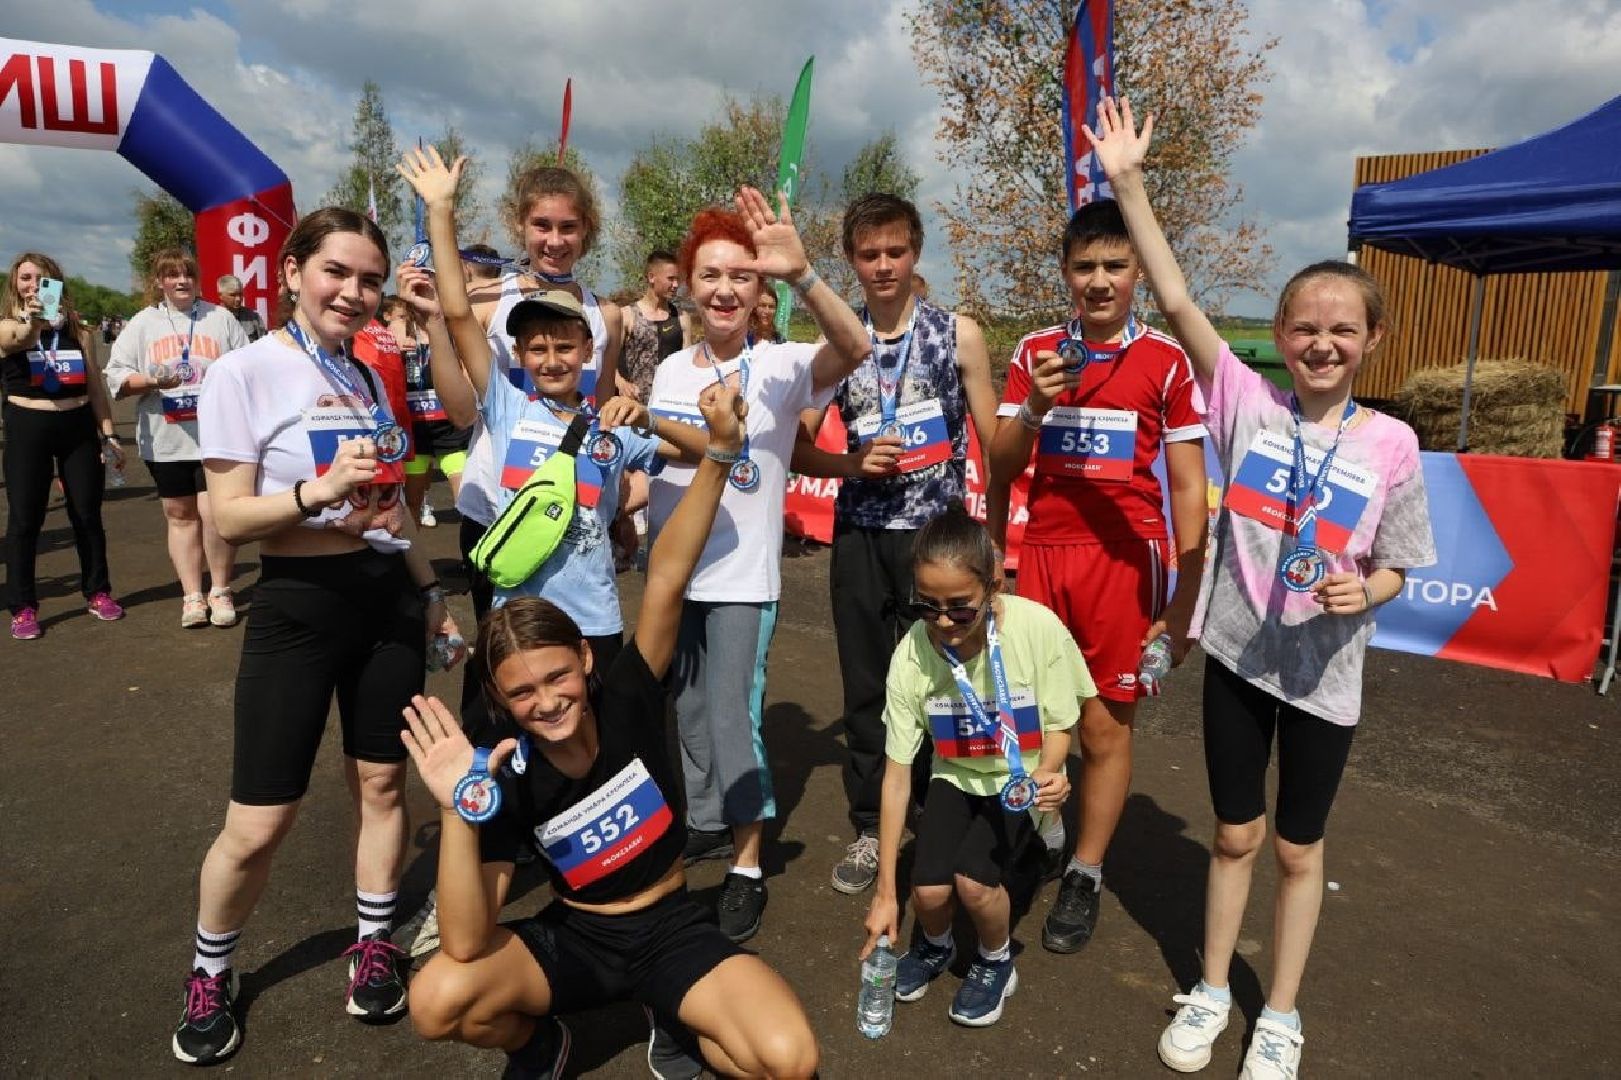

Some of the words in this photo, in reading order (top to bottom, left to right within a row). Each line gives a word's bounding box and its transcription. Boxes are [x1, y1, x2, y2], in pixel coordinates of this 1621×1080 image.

[1061, 430, 1109, 455] 553
[786, 474, 843, 499] УМА
[1397, 577, 1498, 612] ТОРА
[547, 813, 583, 836] КОМАНДА
[580, 804, 640, 854] 552
